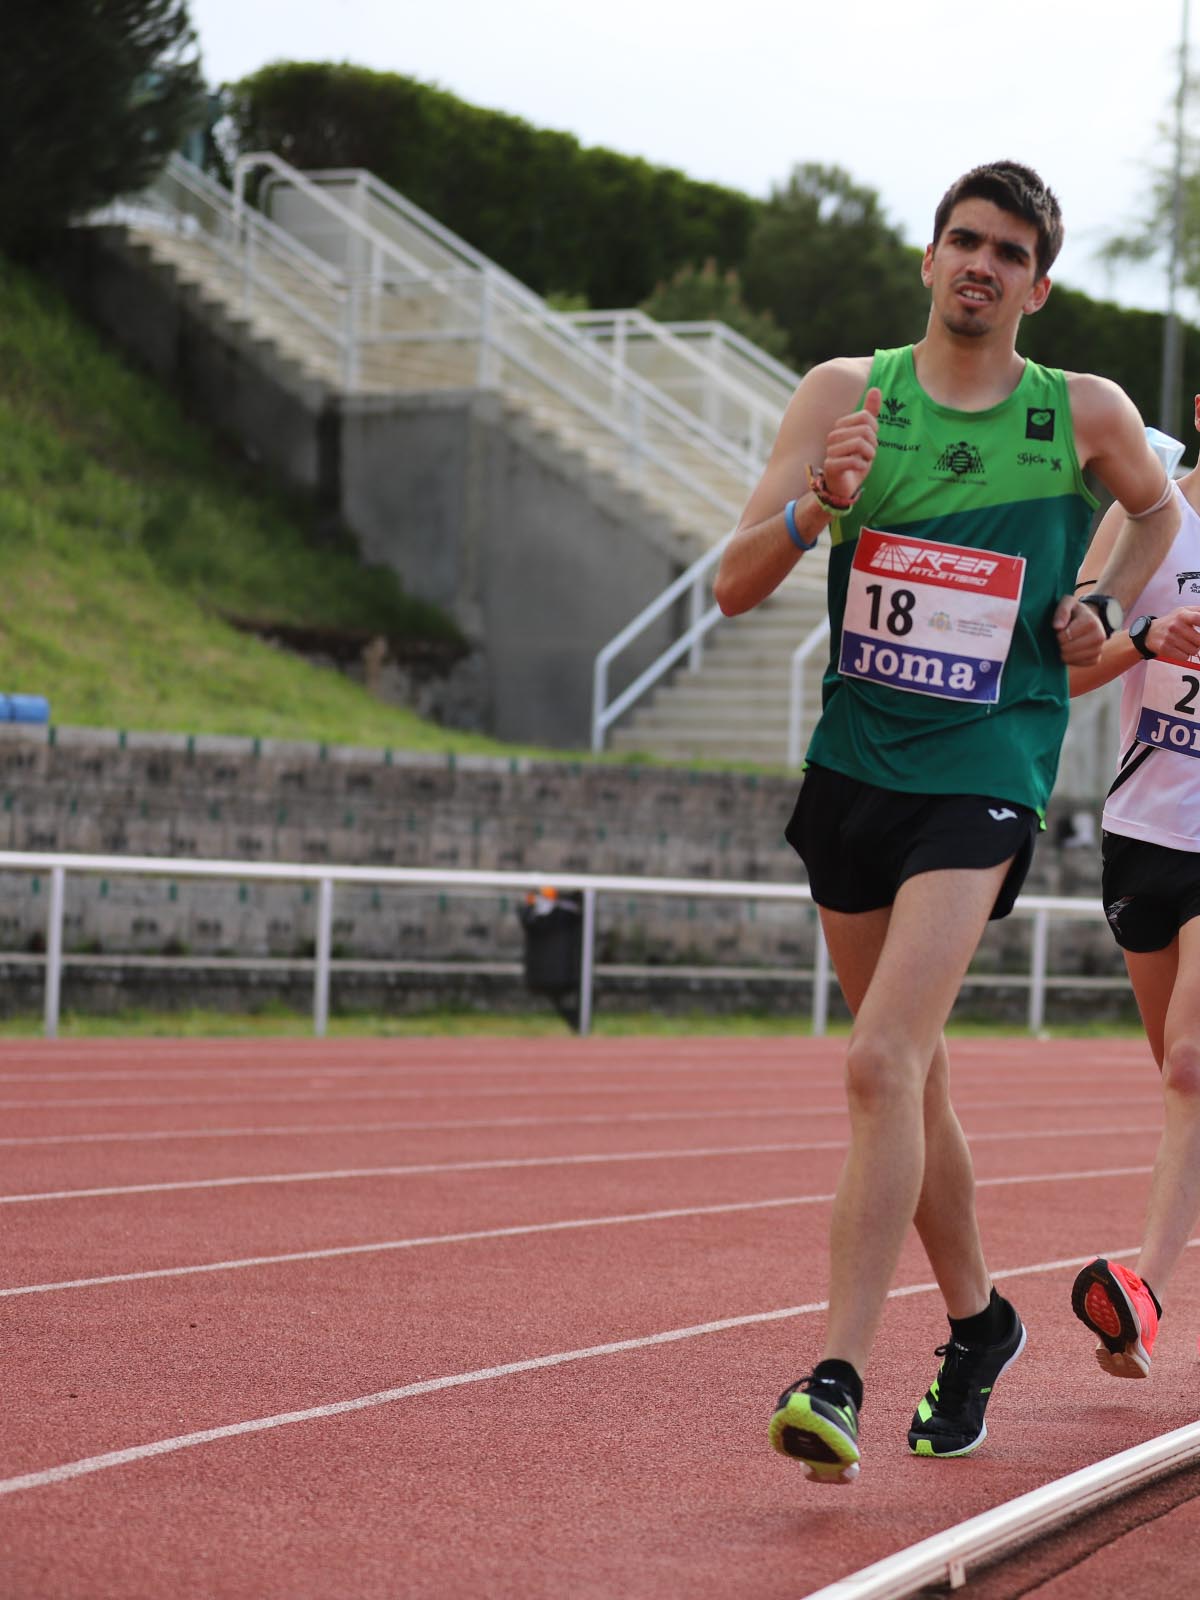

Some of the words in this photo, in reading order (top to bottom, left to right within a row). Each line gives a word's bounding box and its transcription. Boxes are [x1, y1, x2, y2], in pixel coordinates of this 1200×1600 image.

[909, 566, 988, 587] ATLETISMO
[914, 549, 999, 576] RFEA
[865, 583, 916, 636] 18
[1174, 674, 1200, 715] 2
